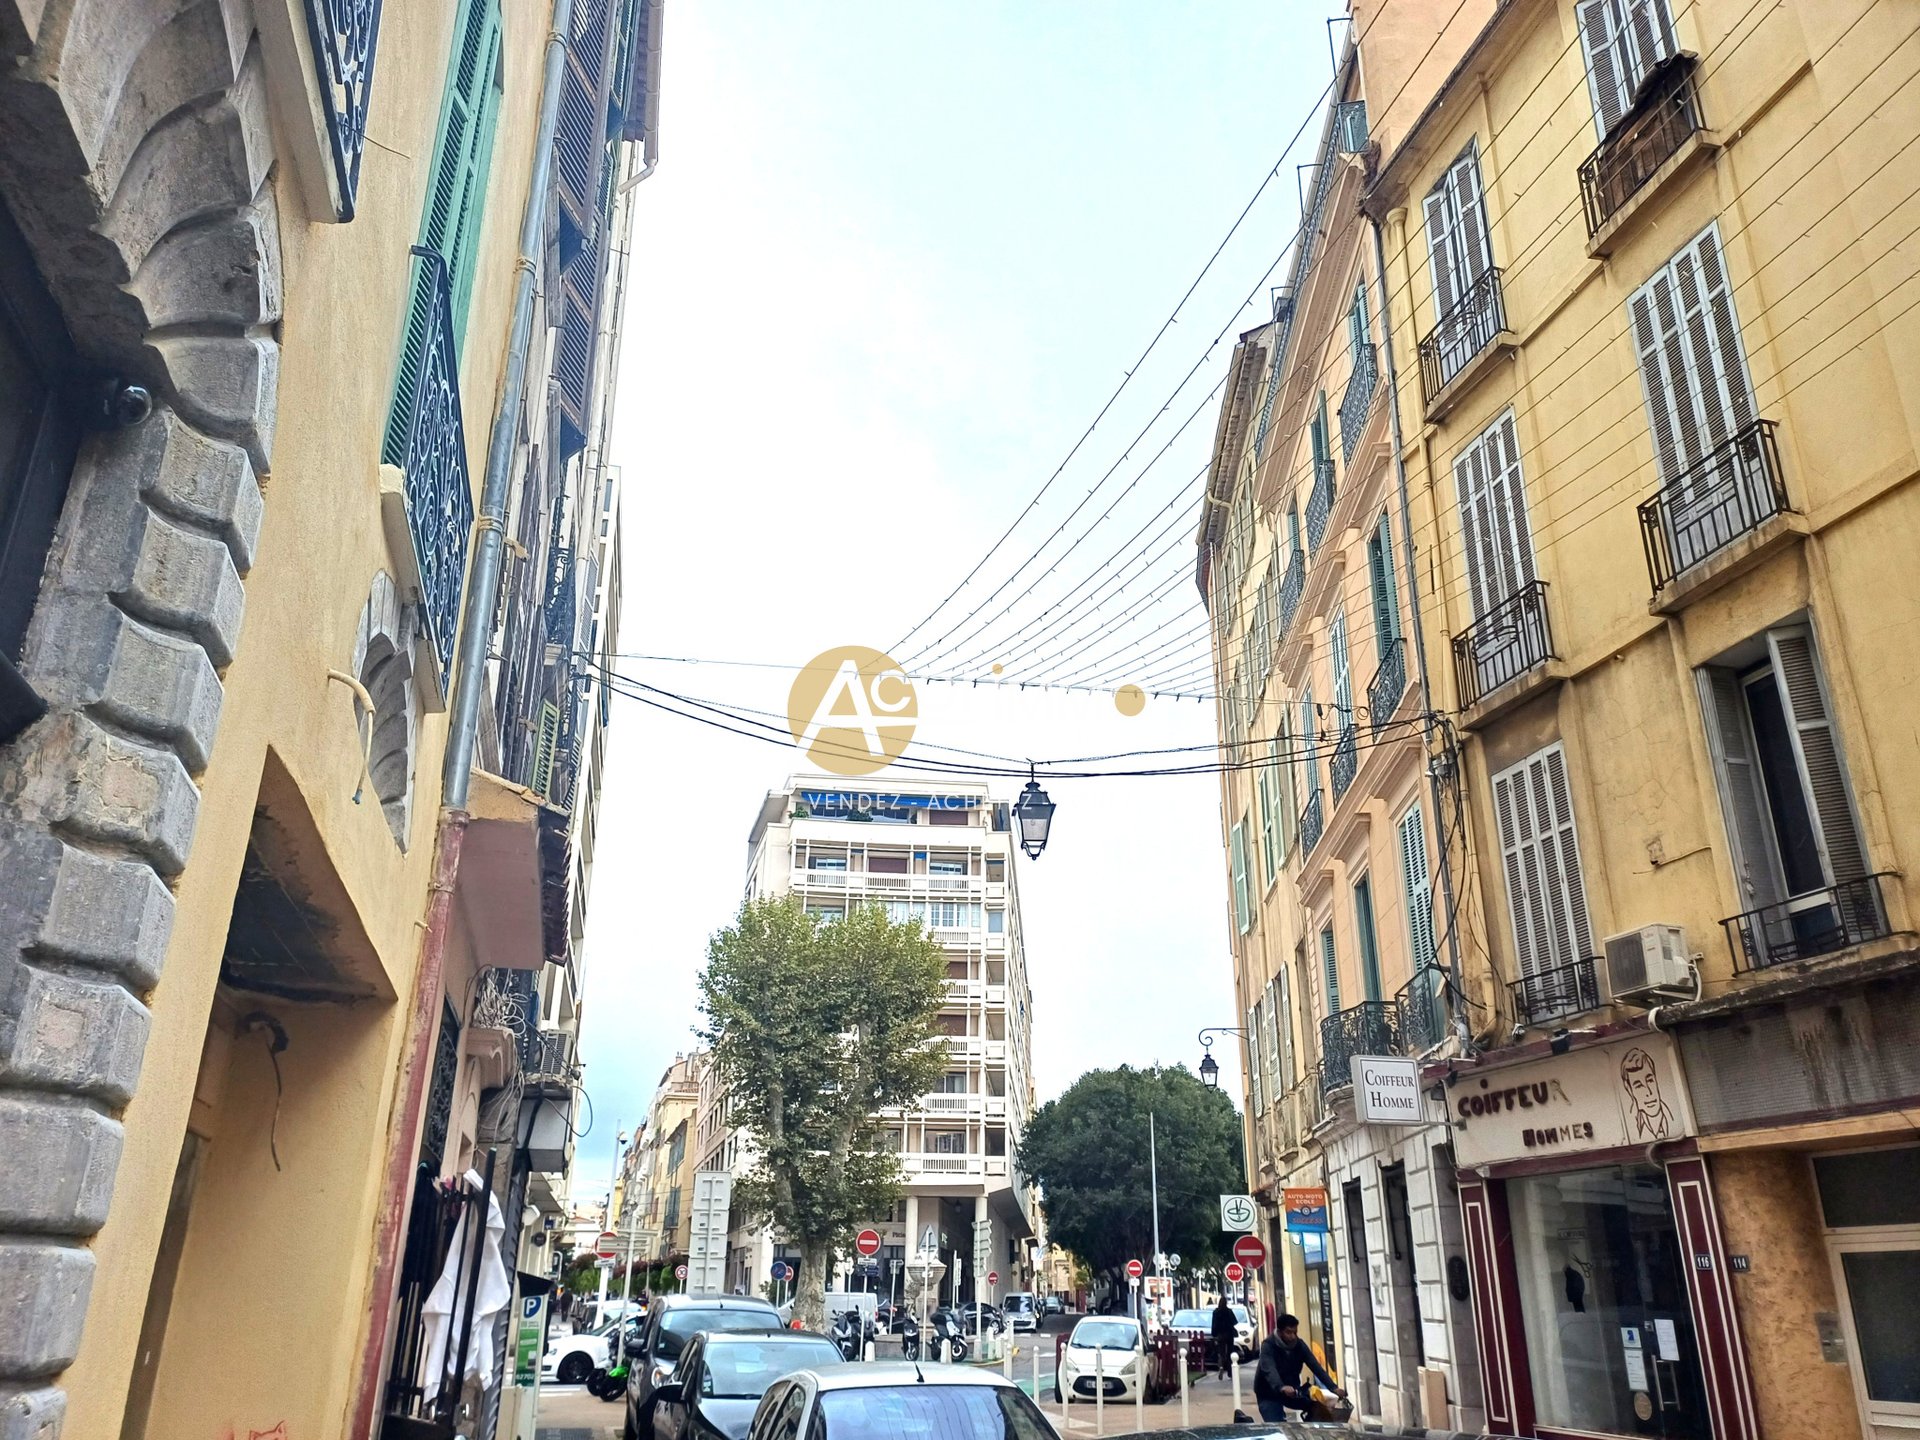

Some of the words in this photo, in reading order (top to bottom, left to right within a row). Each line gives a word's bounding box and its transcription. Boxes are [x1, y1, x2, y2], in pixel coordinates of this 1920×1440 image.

[1522, 1121, 1594, 1148] HOMMES
[1697, 1256, 1710, 1268] 116
[1733, 1257, 1747, 1269] 114
